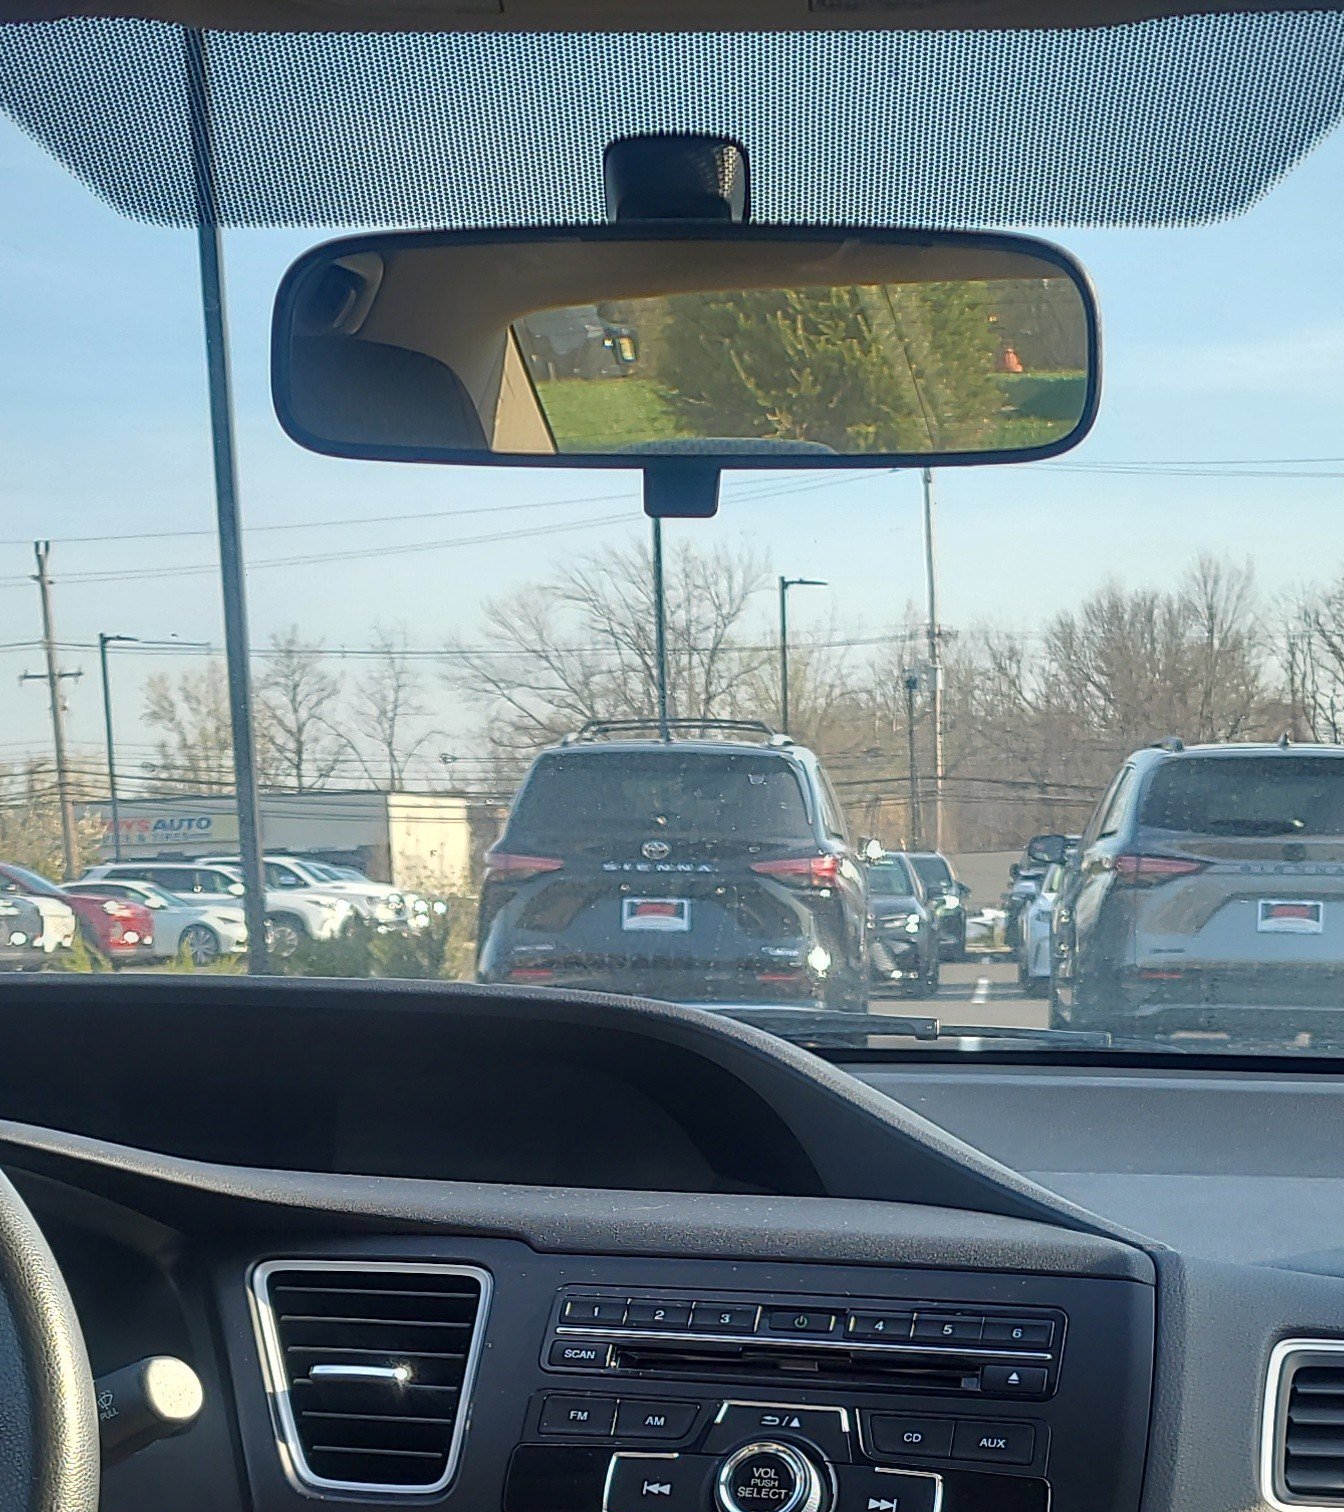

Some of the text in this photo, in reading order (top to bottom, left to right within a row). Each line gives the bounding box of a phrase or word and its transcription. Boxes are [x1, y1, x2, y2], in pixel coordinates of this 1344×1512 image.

[153, 815, 213, 831] AUTO
[592, 1306, 731, 1324] 1 2 3
[874, 1320, 1023, 1339] 4 5 6
[564, 1349, 596, 1360] SCAN
[569, 1410, 588, 1421] FM
[644, 1415, 666, 1427] AM
[903, 1432, 922, 1443] CD
[979, 1437, 1007, 1448] AUX
[753, 1467, 779, 1479] VOL
[750, 1478, 779, 1488] PUSH
[737, 1486, 788, 1500] SELECT
